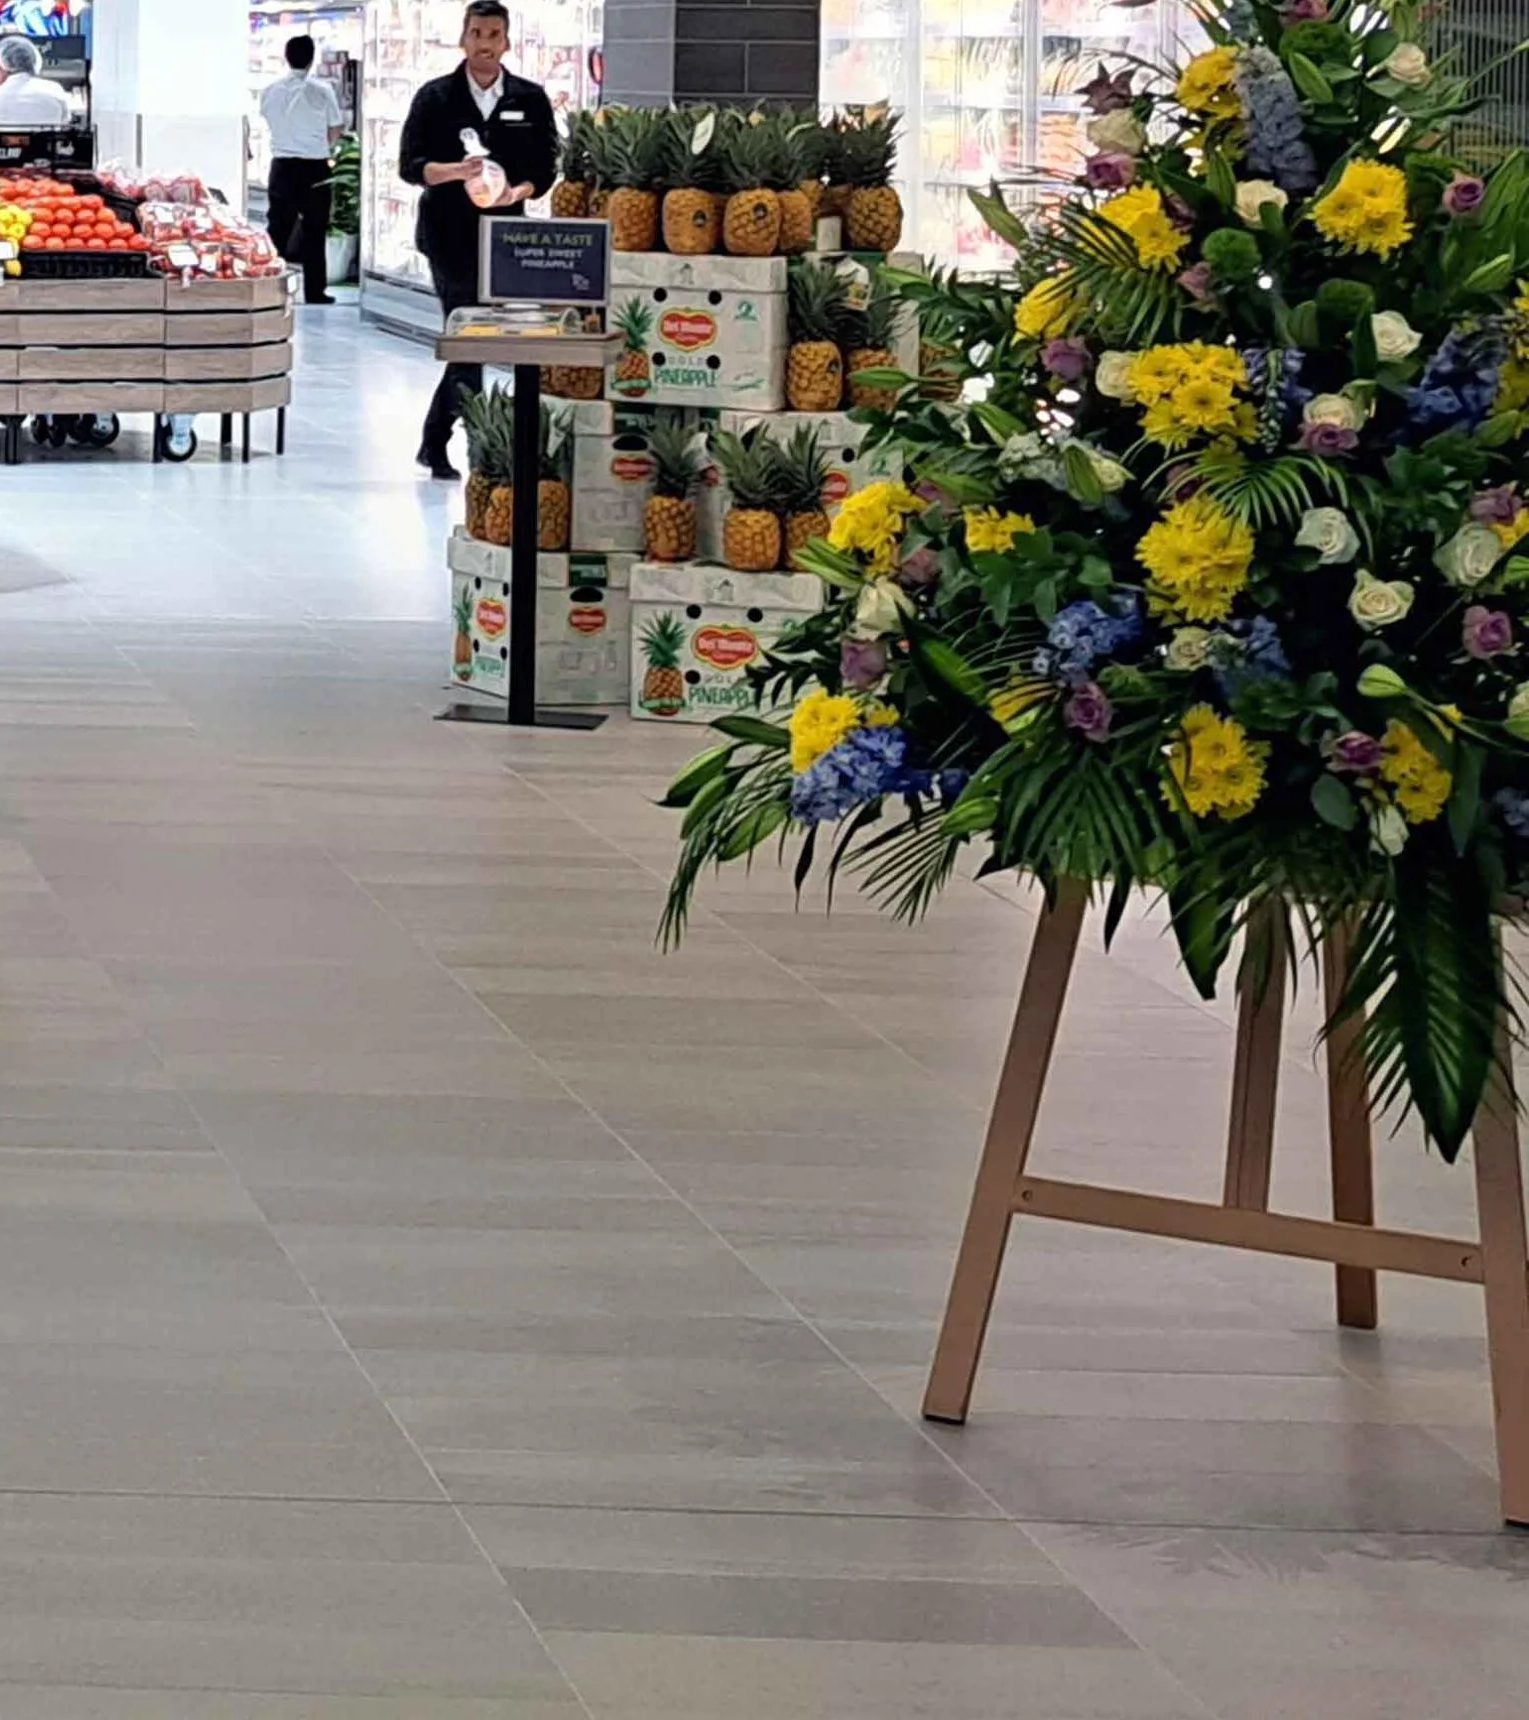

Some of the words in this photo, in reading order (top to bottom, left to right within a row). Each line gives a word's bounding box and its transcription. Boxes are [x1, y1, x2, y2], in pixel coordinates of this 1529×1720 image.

[503, 232, 539, 244] HAVE
[554, 233, 593, 246] TASTE
[654, 367, 718, 389] PINEAPPLE
